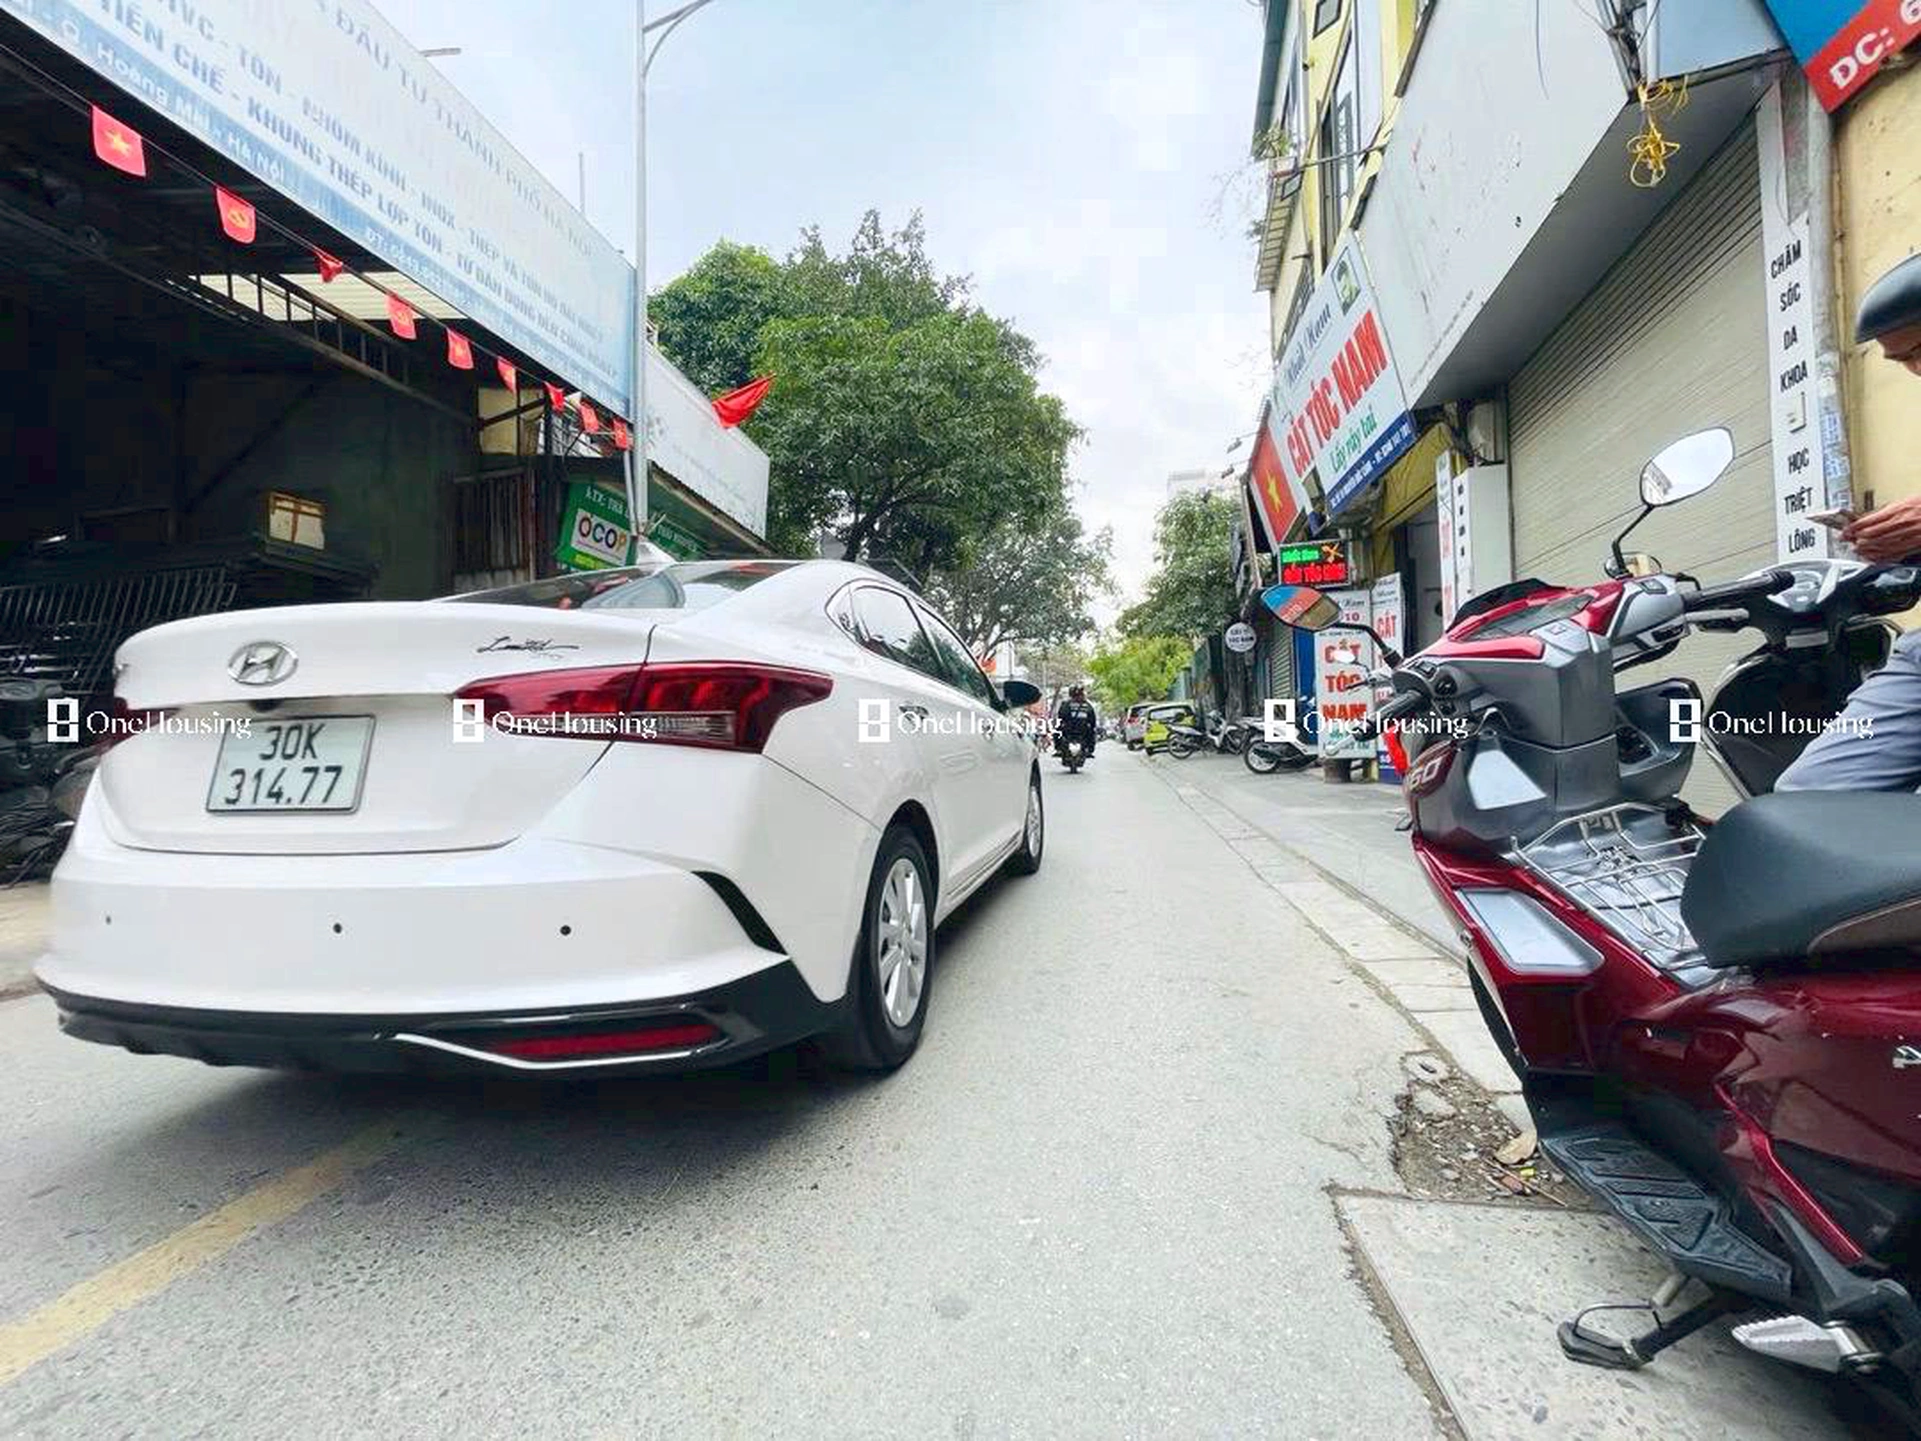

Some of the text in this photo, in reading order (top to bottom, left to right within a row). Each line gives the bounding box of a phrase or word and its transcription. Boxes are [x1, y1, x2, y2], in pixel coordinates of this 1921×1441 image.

[1780, 283, 1801, 312] SÓC
[1306, 378, 1340, 449] TÓC
[1331, 310, 1387, 415] NAM
[1779, 360, 1808, 393] KHOA
[1787, 447, 1810, 474] HỌC
[1784, 486, 1812, 514] TRIỆT
[1788, 528, 1816, 554] LÔNG
[259, 723, 323, 761] 30K
[225, 765, 343, 806] 314.77
